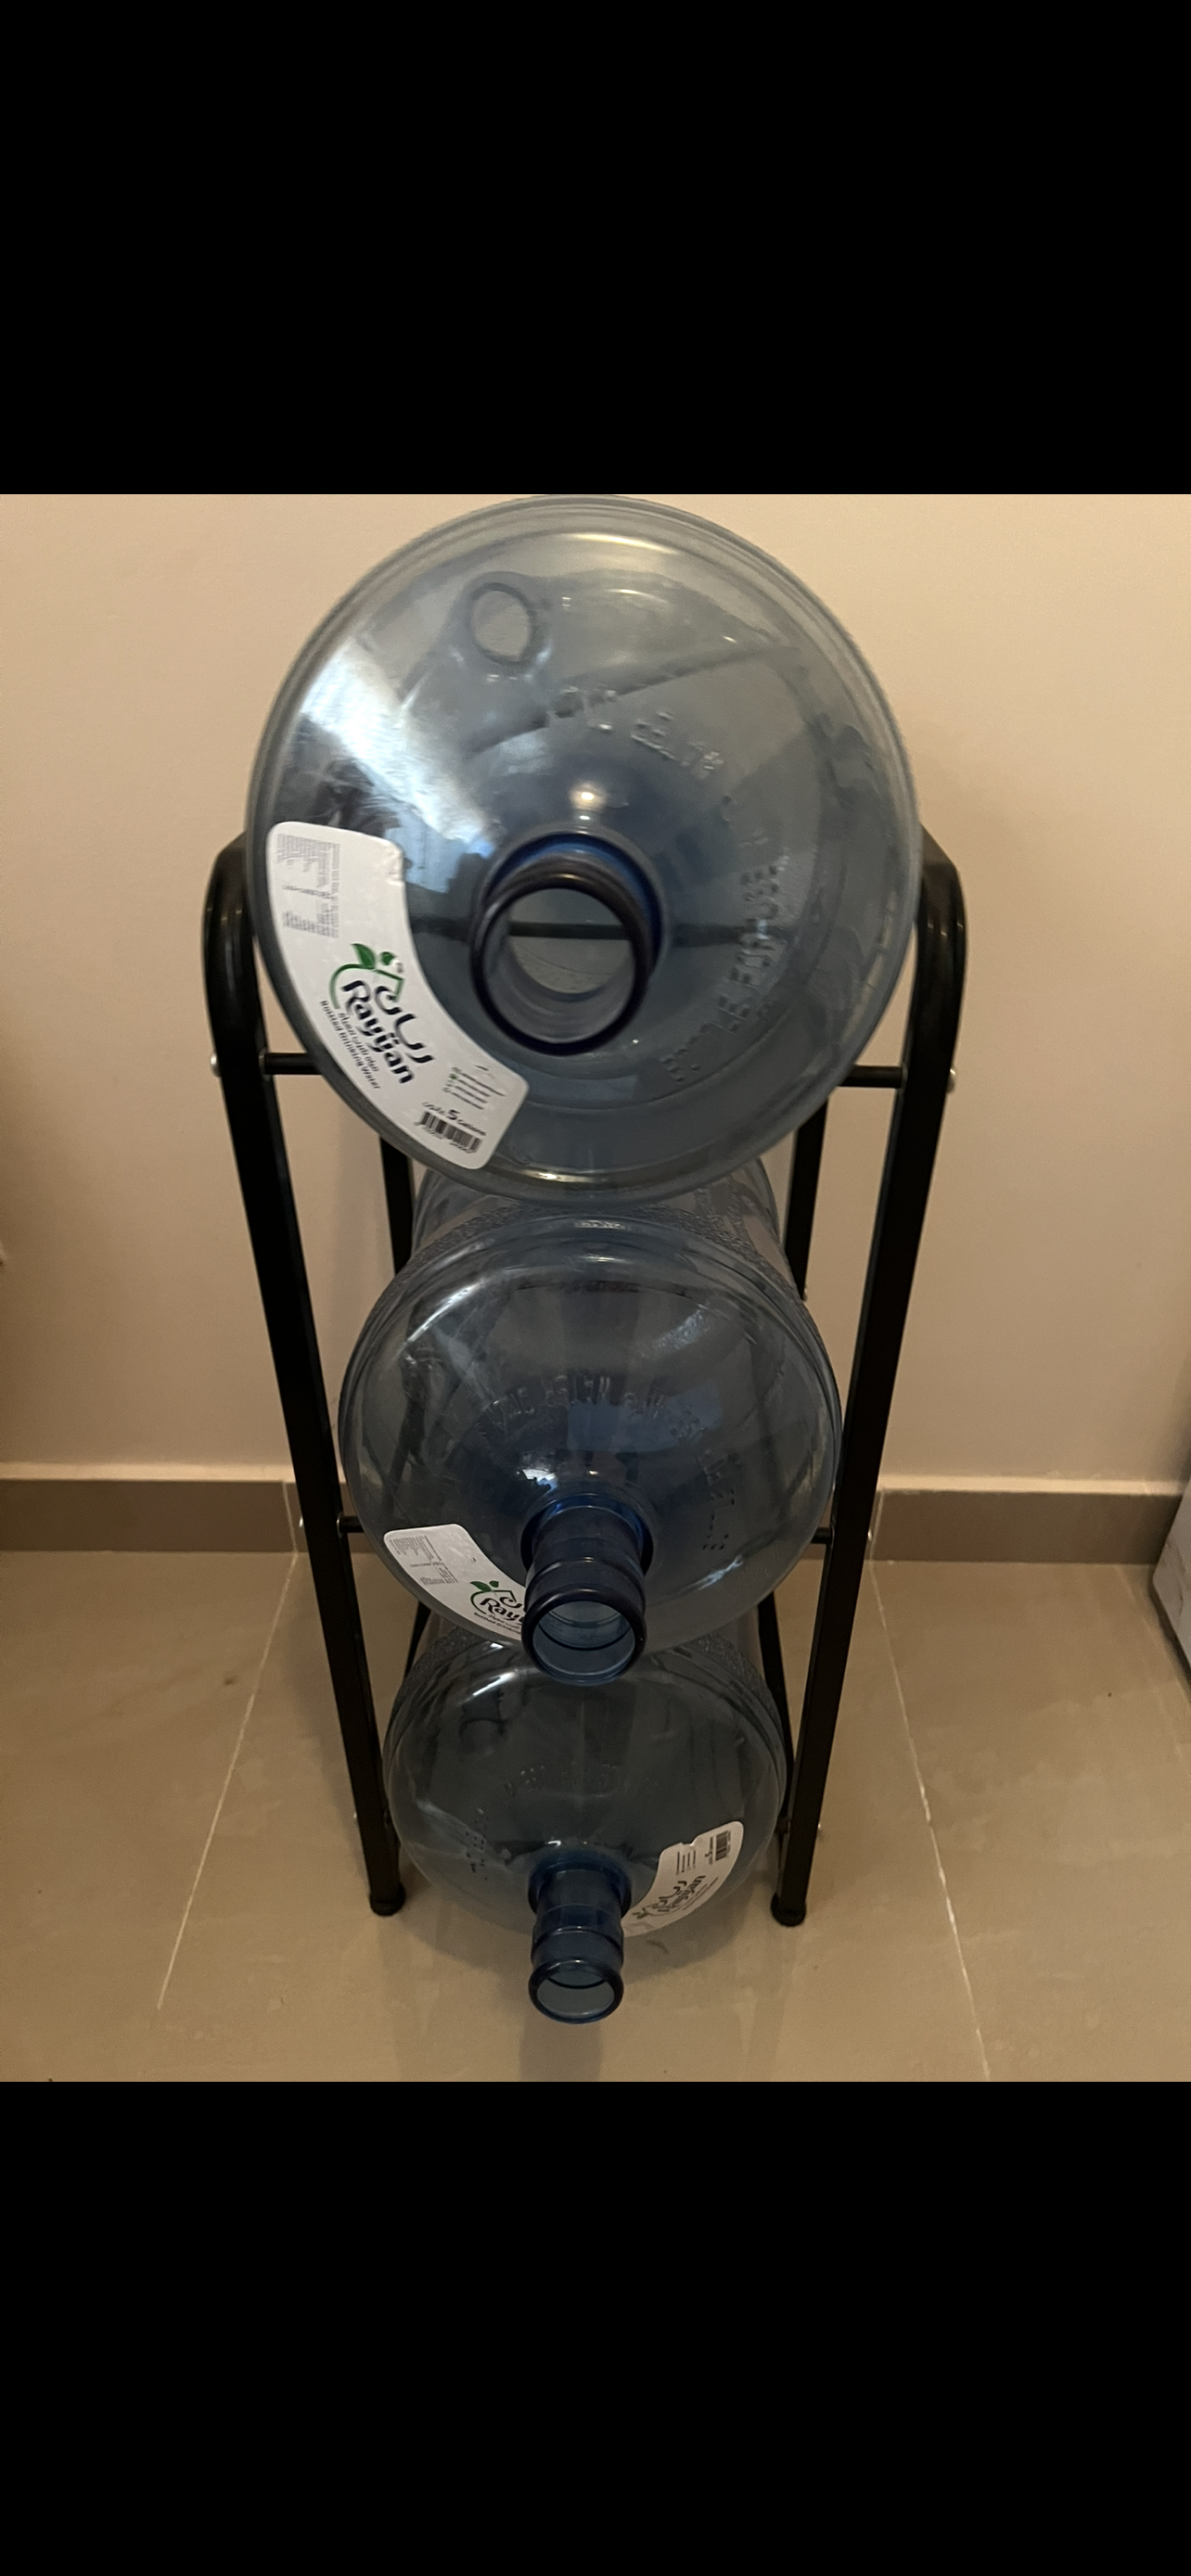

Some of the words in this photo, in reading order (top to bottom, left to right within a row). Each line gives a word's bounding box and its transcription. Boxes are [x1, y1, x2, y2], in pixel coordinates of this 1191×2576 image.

[340, 979, 414, 1084] Rayyan
[375, 985, 435, 1065] ريان
[446, 1109, 461, 1121] 5
[480, 1597, 523, 1626] Ray
